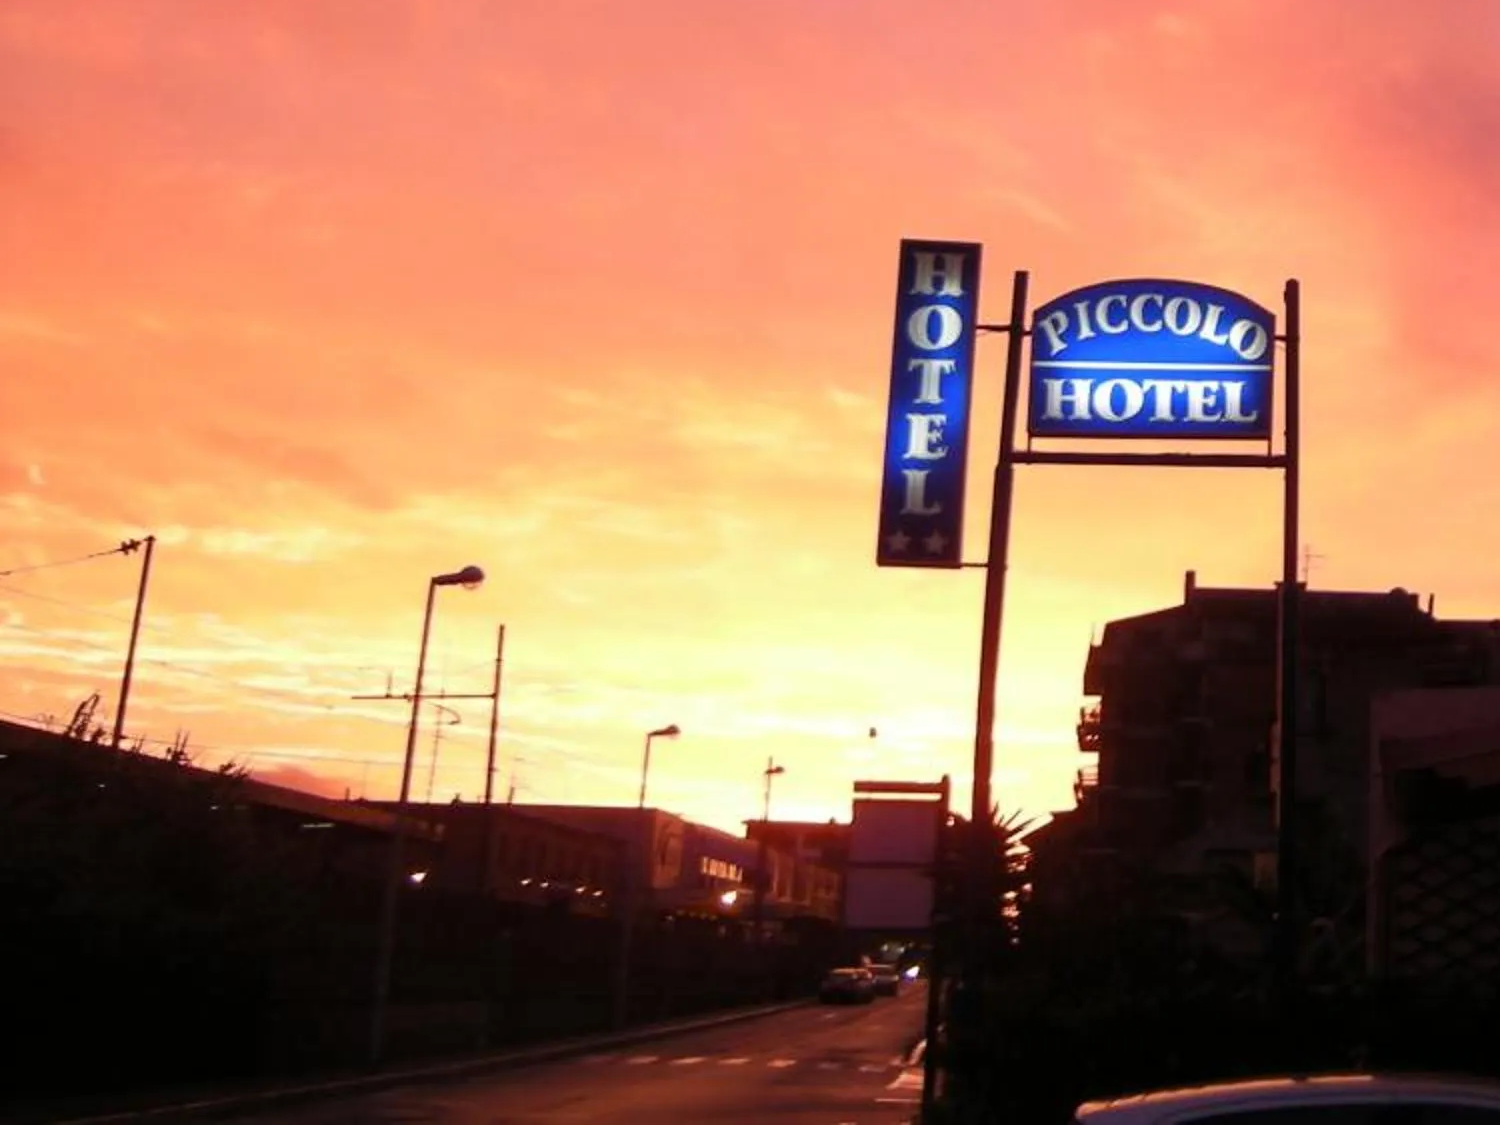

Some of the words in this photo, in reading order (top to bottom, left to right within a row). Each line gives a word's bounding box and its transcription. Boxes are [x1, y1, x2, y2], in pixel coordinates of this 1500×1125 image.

[1038, 294, 1267, 360] PICCOLO
[901, 251, 967, 515] HOTEL
[1041, 378, 1257, 423] HOTEL
